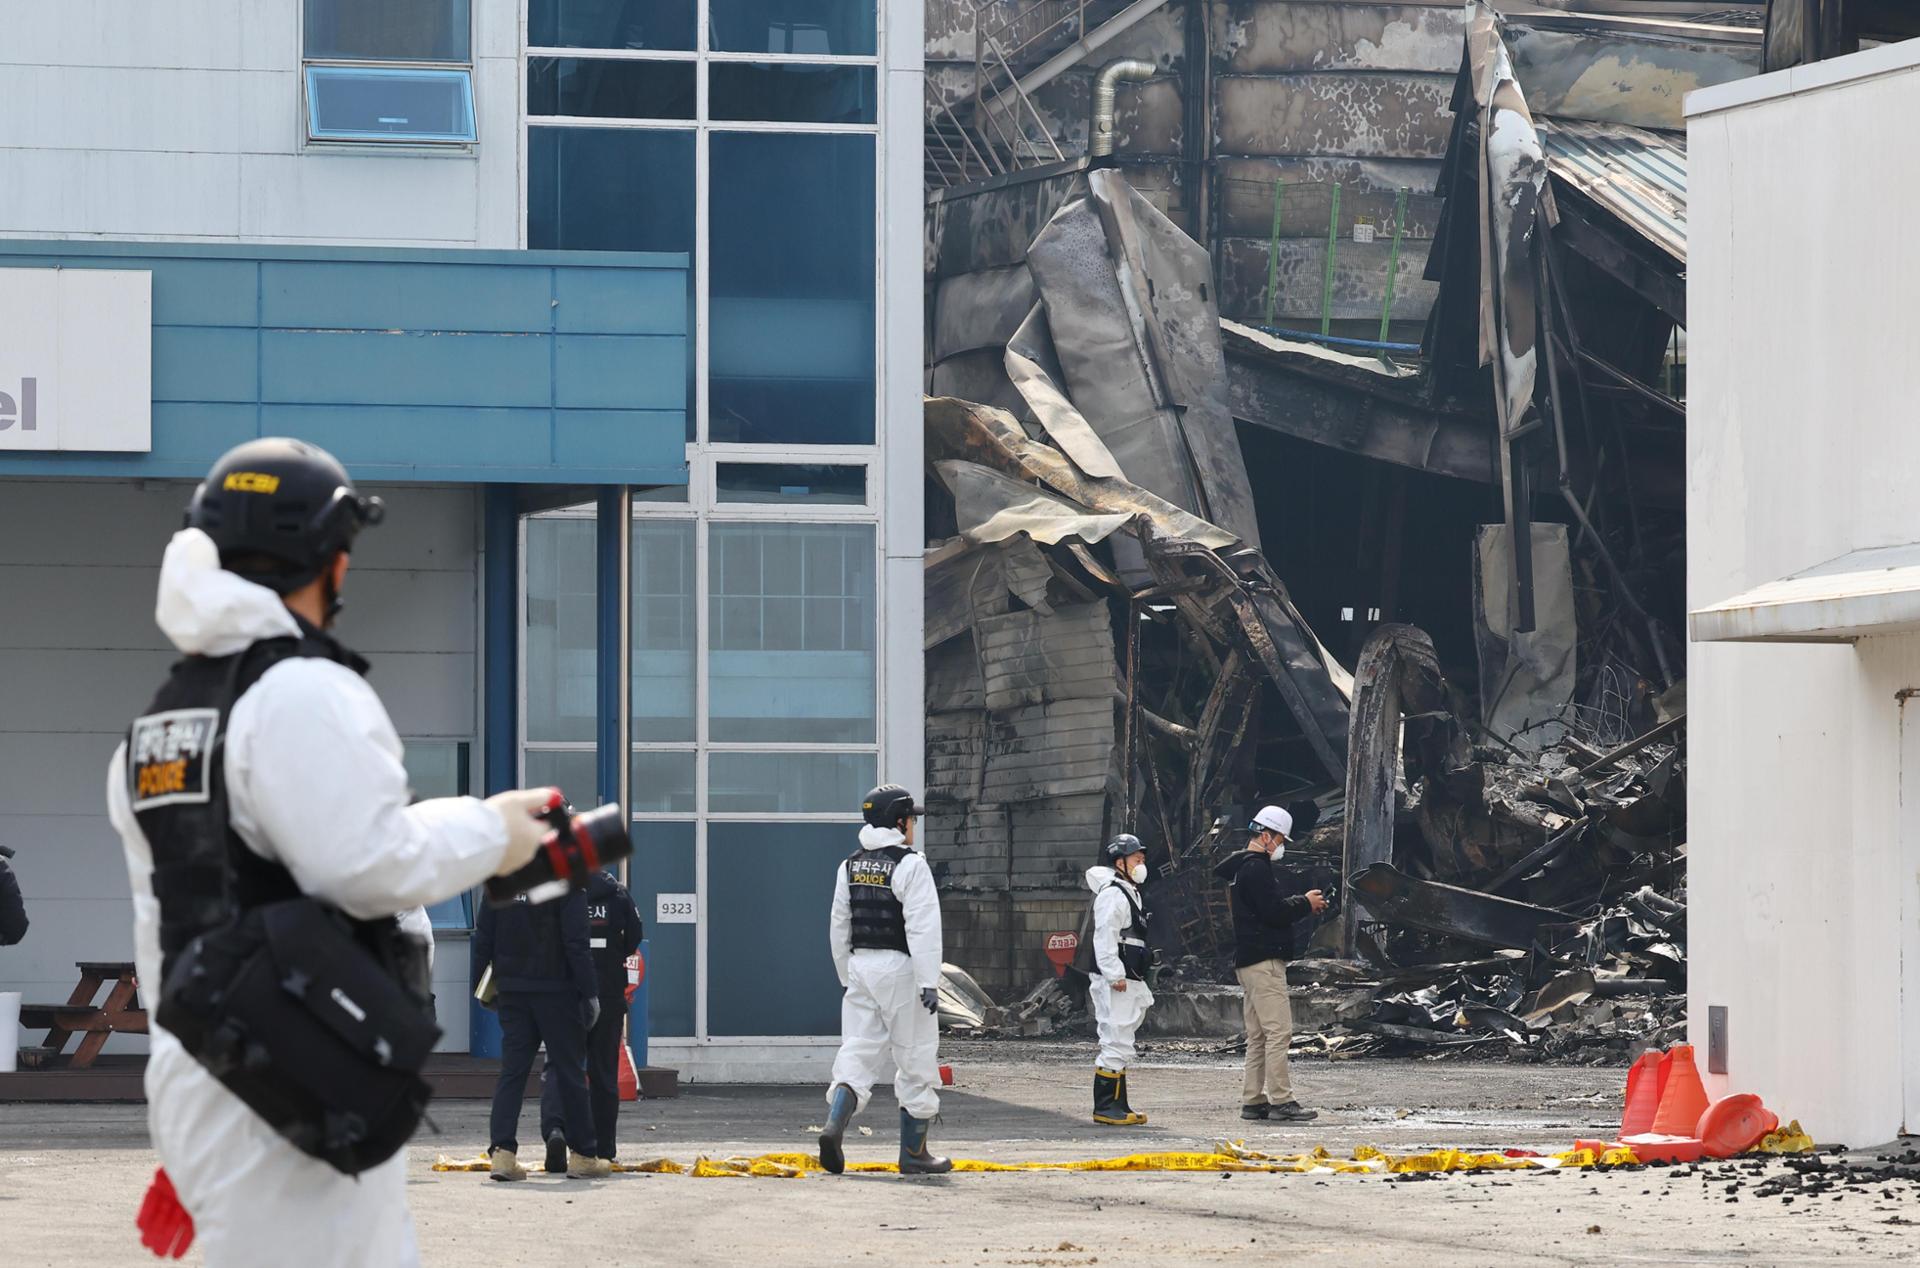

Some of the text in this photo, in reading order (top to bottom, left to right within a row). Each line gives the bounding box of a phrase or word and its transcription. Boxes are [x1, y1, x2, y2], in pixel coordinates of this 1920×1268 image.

[138, 758, 187, 799] POLICE
[852, 861, 892, 876] 과학수사
[854, 873, 886, 885] POLICE
[662, 903, 692, 915] 9323
